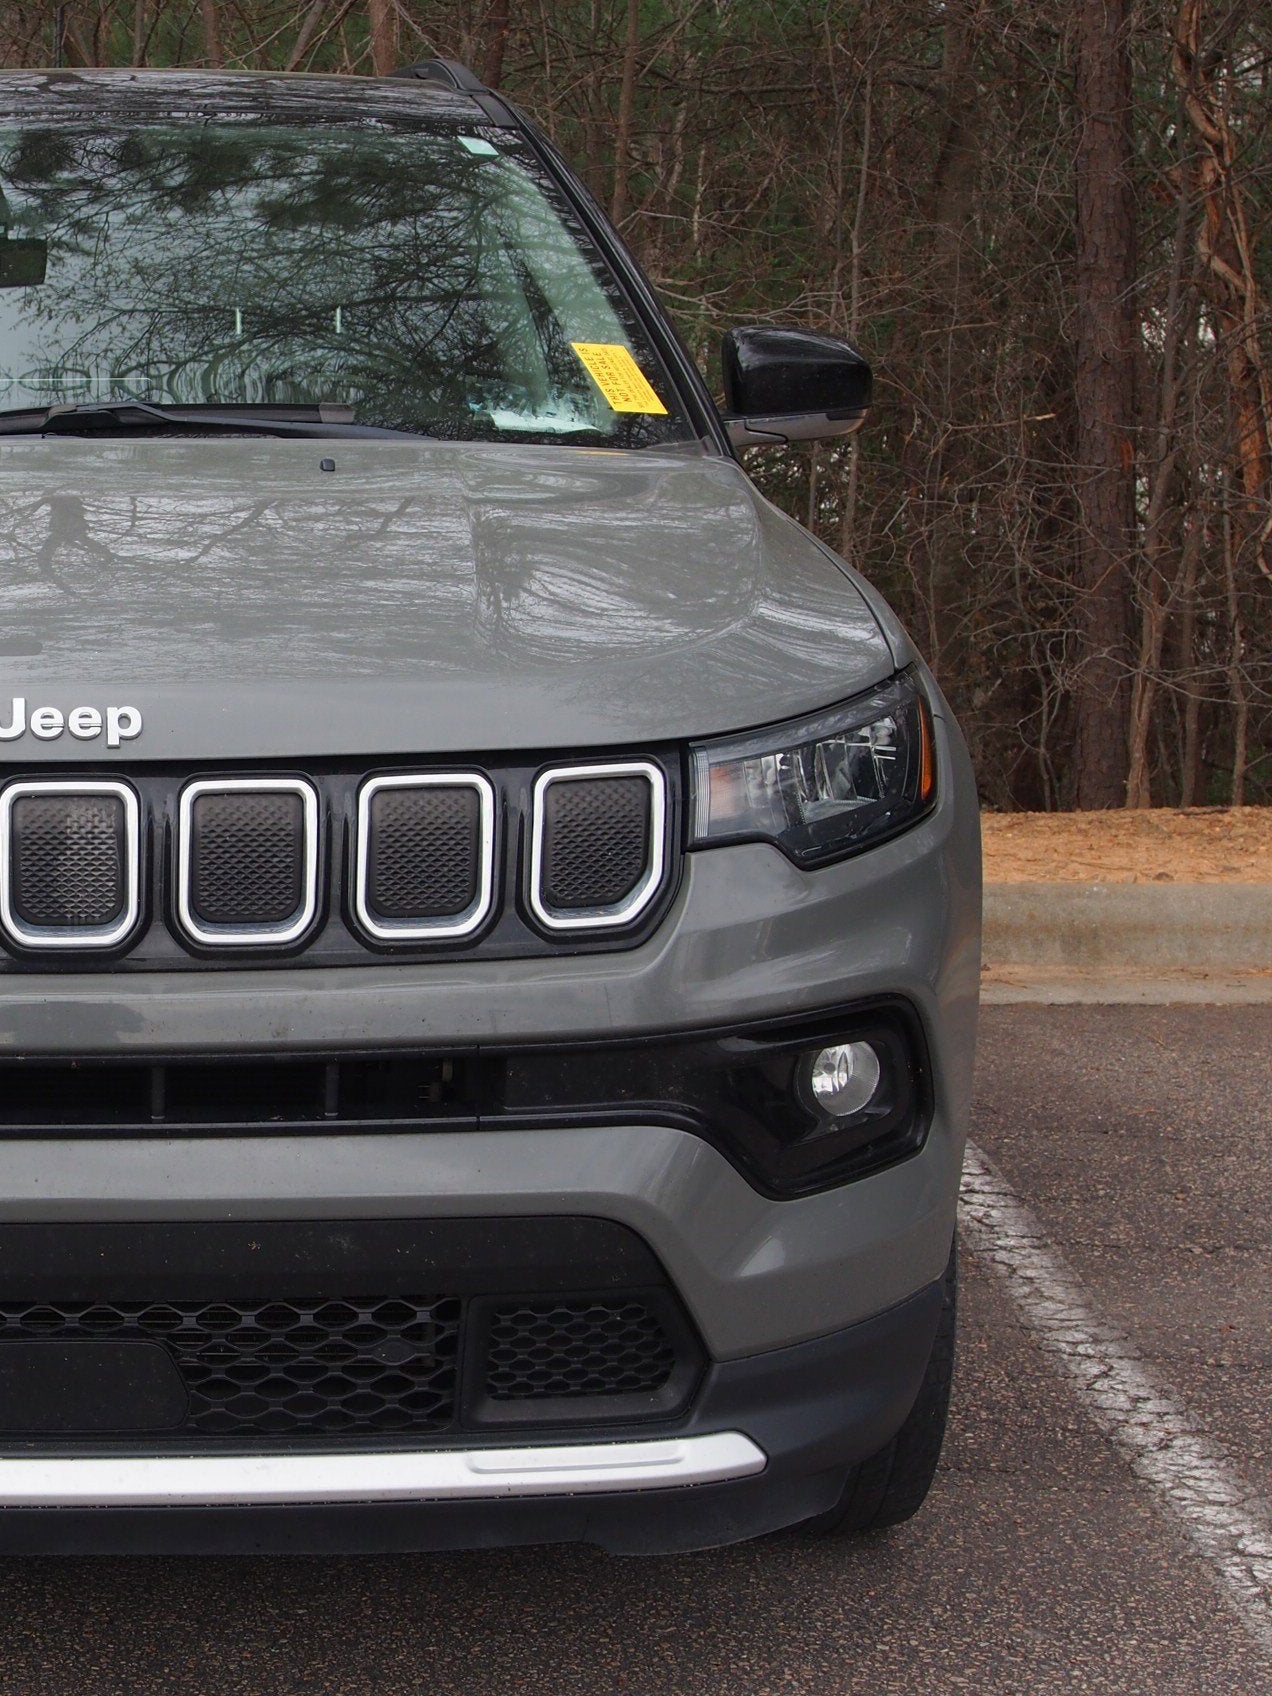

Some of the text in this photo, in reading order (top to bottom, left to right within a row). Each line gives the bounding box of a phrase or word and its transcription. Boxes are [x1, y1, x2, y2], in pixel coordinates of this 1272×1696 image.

[592, 351, 611, 370] SALE
[578, 347, 623, 405] THIS VEHICLE IS
[605, 371, 621, 386] FOR
[616, 388, 633, 403] NOT
